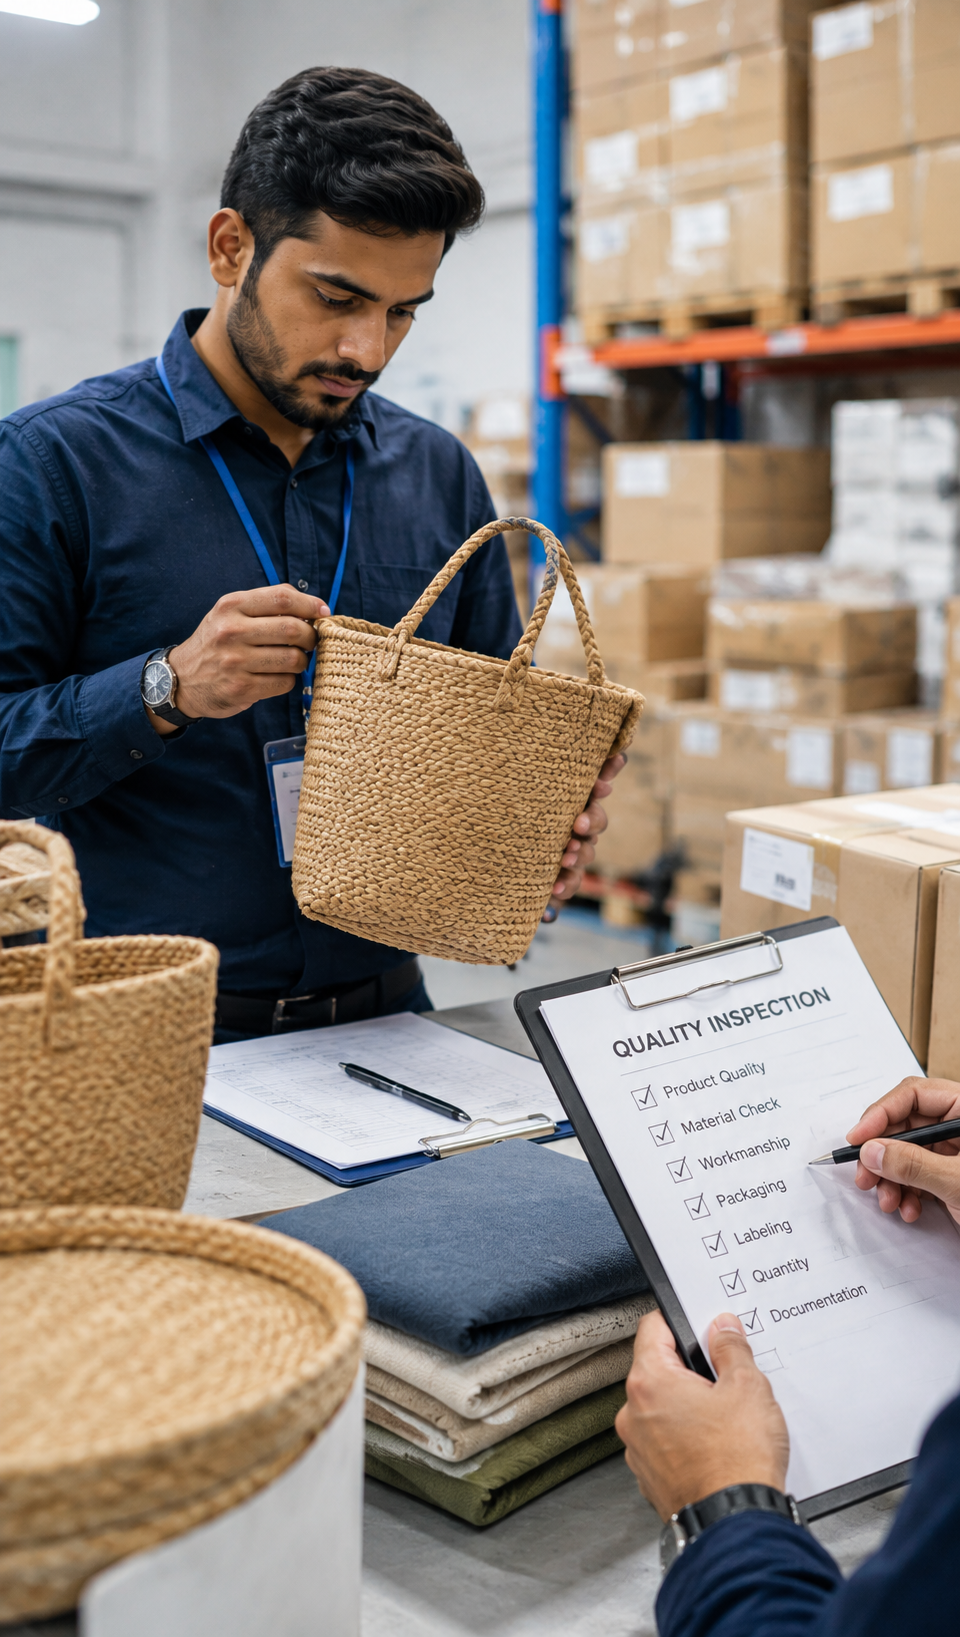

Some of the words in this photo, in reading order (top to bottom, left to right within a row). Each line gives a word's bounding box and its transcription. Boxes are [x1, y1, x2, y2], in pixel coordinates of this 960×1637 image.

[612, 1019, 703, 1058] QUALITY
[706, 986, 832, 1034] INSPECTION
[662, 1074, 718, 1099] Product
[719, 1061, 766, 1084] Quality
[680, 1108, 737, 1135] Material
[738, 1096, 782, 1118] Check
[697, 1135, 791, 1171] Workmanship
[715, 1178, 788, 1208] Packaging
[733, 1220, 793, 1246] Labeling
[752, 1257, 810, 1284] Quantity
[769, 1284, 868, 1323] Documentation
